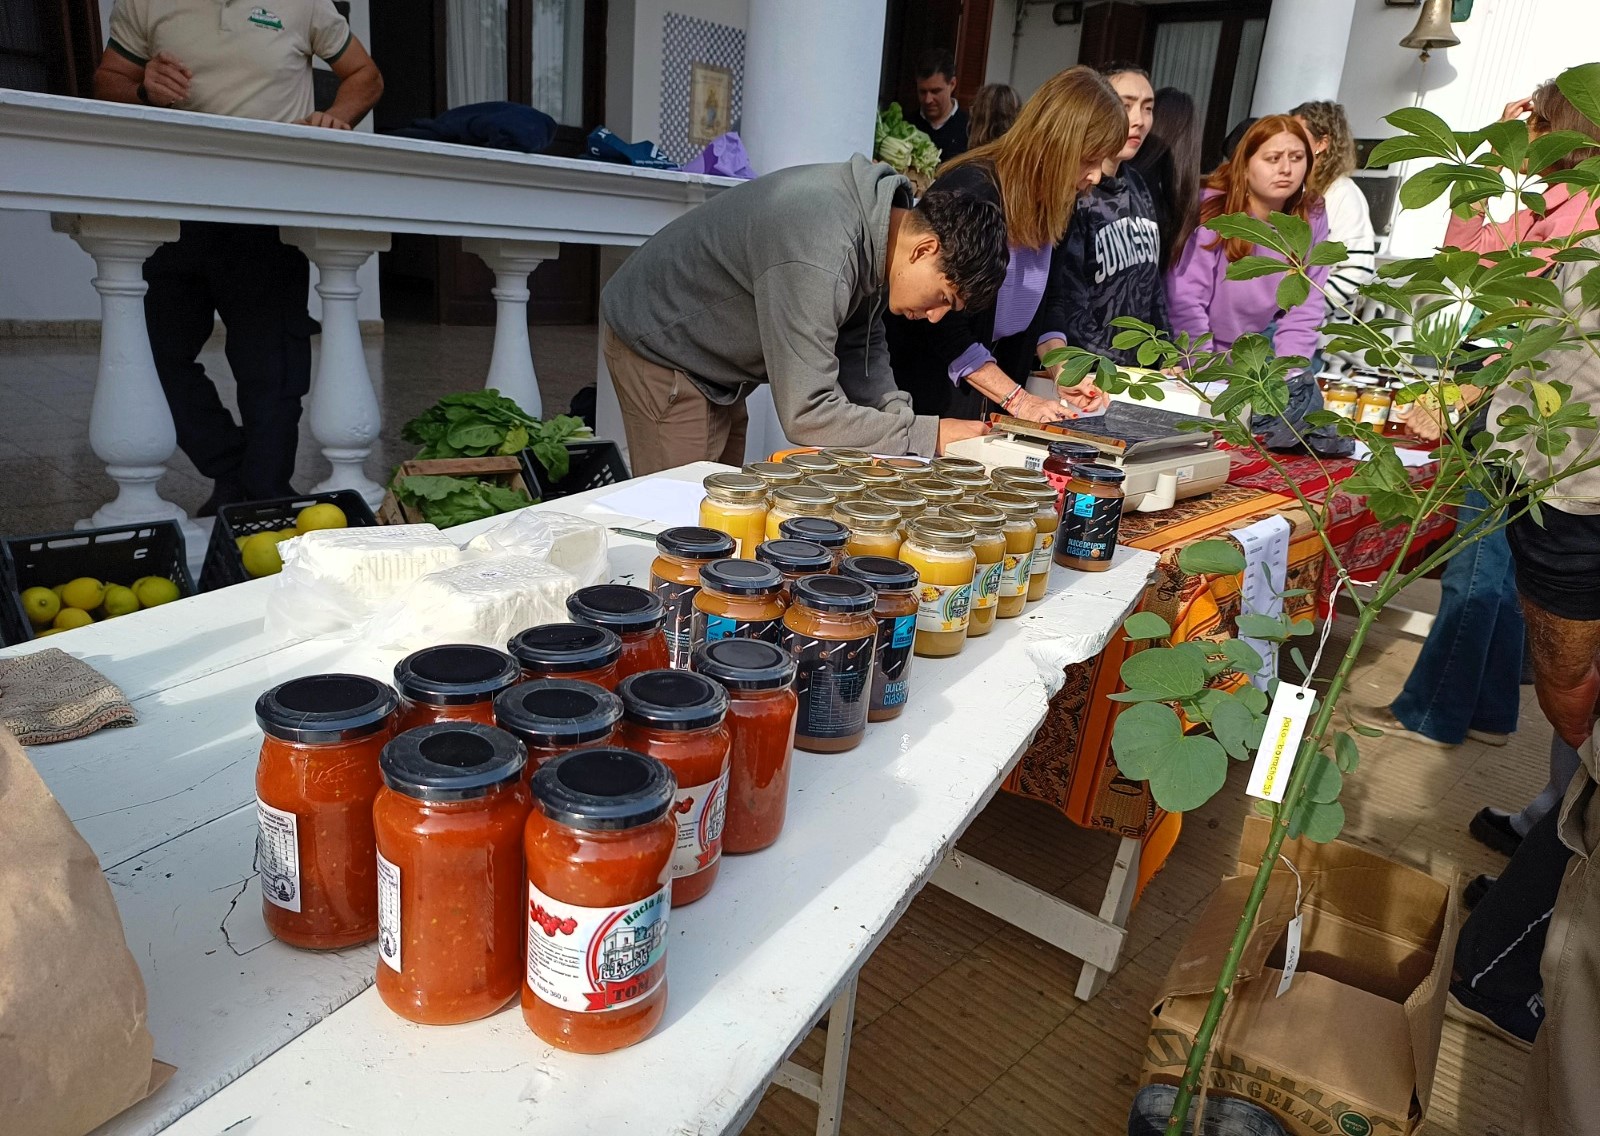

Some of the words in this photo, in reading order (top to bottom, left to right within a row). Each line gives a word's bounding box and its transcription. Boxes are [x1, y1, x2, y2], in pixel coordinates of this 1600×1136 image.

[1094, 216, 1160, 285] SUNKISS
[610, 950, 650, 978] Escuela
[1198, 1066, 1346, 1136] ONGELAD
